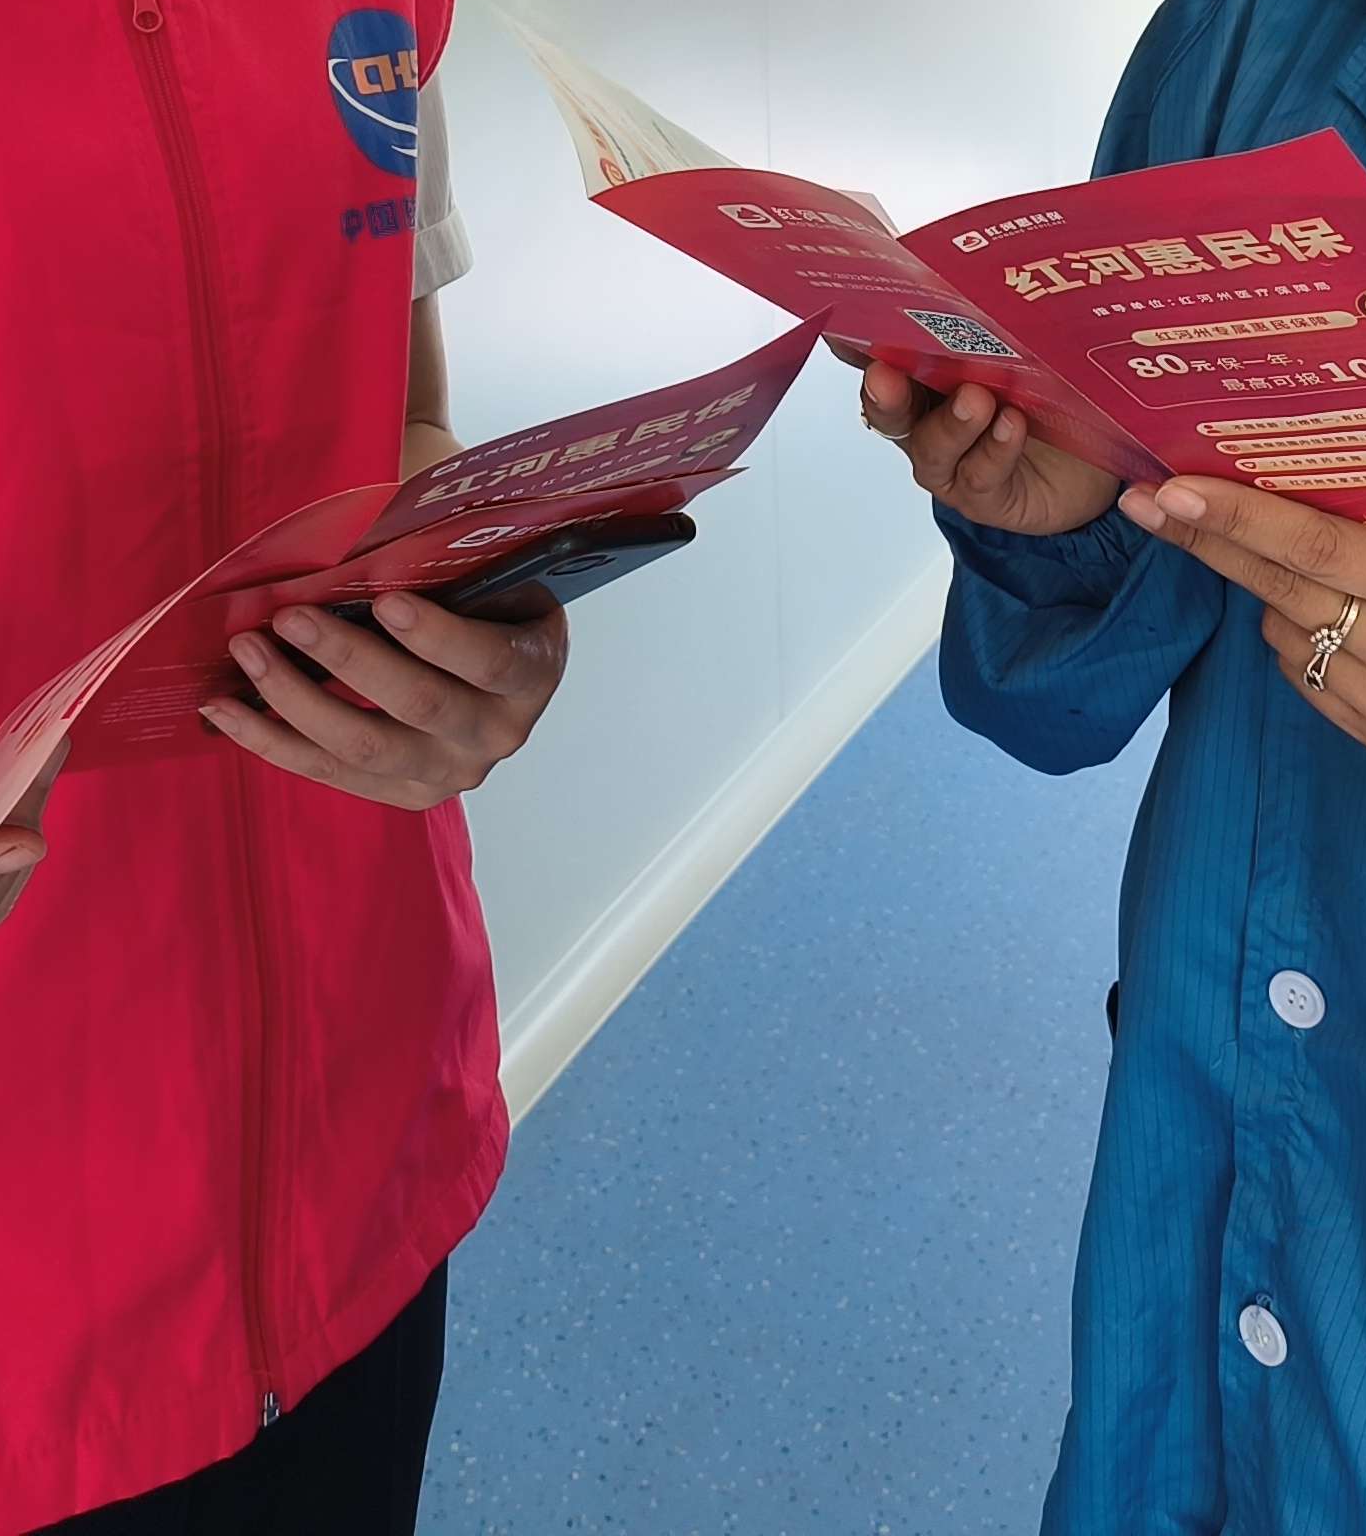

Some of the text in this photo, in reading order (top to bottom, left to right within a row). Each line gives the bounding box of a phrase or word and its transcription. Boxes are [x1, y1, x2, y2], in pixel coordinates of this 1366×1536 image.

[1003, 216, 1354, 303] 红河惠民保
[1154, 315, 1330, 342] 红河州专属惠民保障
[414, 383, 757, 510] 红河惠民保
